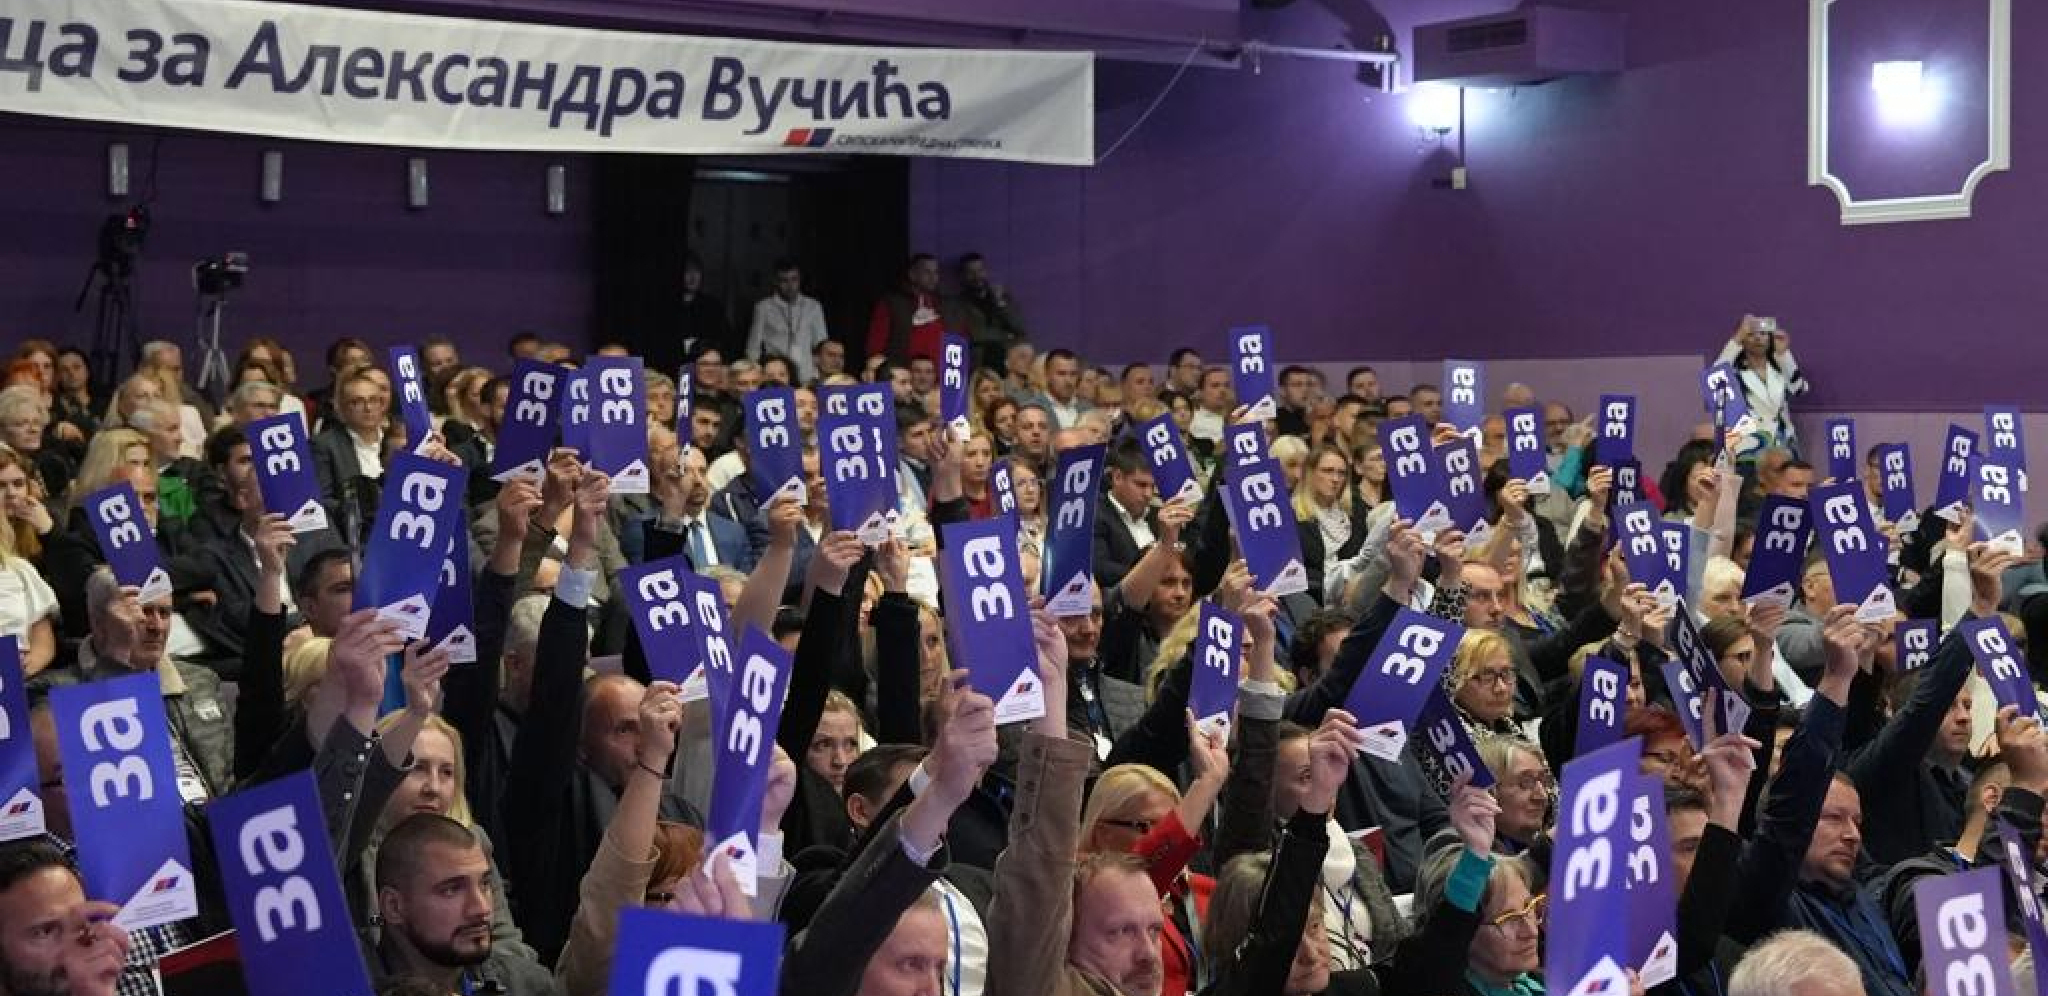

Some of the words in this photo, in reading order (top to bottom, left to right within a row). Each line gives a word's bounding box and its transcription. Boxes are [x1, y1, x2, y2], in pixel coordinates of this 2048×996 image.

[117, 28, 210, 88] за
[224, 20, 685, 136] Александра
[702, 56, 951, 135] Вучића
[398, 355, 422, 403] за
[946, 345, 962, 389] за
[1240, 335, 1264, 373] за
[516, 371, 554, 425] за
[600, 369, 634, 423] за
[1452, 367, 1474, 405] за
[756, 399, 788, 447] за
[1148, 423, 1176, 465] за
[1514, 413, 1538, 451] за
[1606, 403, 1628, 437] за
[1832, 425, 1850, 457] за
[1992, 413, 2016, 447] за
[262, 423, 300, 475] за
[830, 425, 868, 481] за
[1390, 427, 1426, 477] за
[1446, 449, 1474, 497] за
[1886, 451, 1906, 489] за
[1948, 435, 1970, 477] за
[390, 473, 448, 547] за
[996, 469, 1014, 511] за
[1058, 459, 1092, 531] за
[1242, 473, 1282, 531] за
[1980, 465, 2010, 503] за
[100, 493, 140, 547] за
[1626, 511, 1656, 555] за
[1766, 507, 1802, 553] за
[1824, 495, 1866, 553] за
[638, 569, 688, 631] за
[964, 537, 1012, 621] за
[696, 591, 732, 673] за
[1206, 617, 1232, 675] за
[1382, 625, 1444, 683] за
[1976, 627, 2020, 679] за
[730, 655, 776, 765] за
[1590, 669, 1618, 727] за
[80, 697, 152, 807] за
[1564, 769, 1620, 899] за
[240, 805, 320, 941] за
[1938, 893, 1996, 996] за
